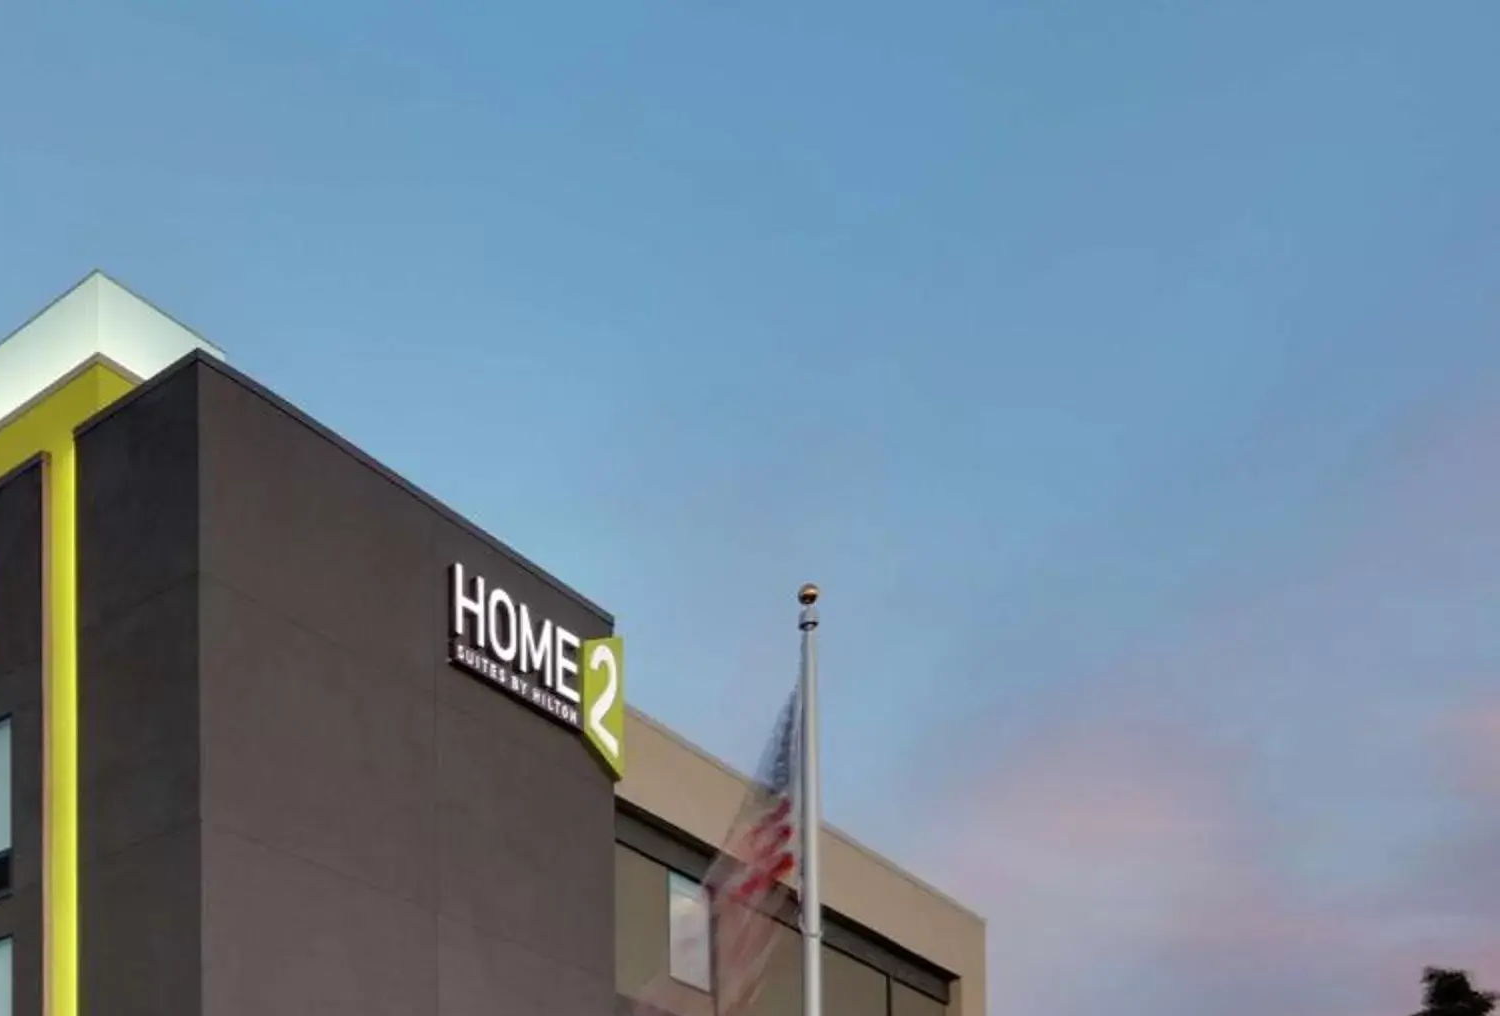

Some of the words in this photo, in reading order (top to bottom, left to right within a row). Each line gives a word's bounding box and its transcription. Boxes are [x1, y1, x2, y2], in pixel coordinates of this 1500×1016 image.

[454, 562, 581, 703] HOME
[589, 644, 619, 758] 2
[457, 644, 506, 683] SUITES
[511, 675, 528, 695] BY
[532, 688, 578, 725] HILTON
